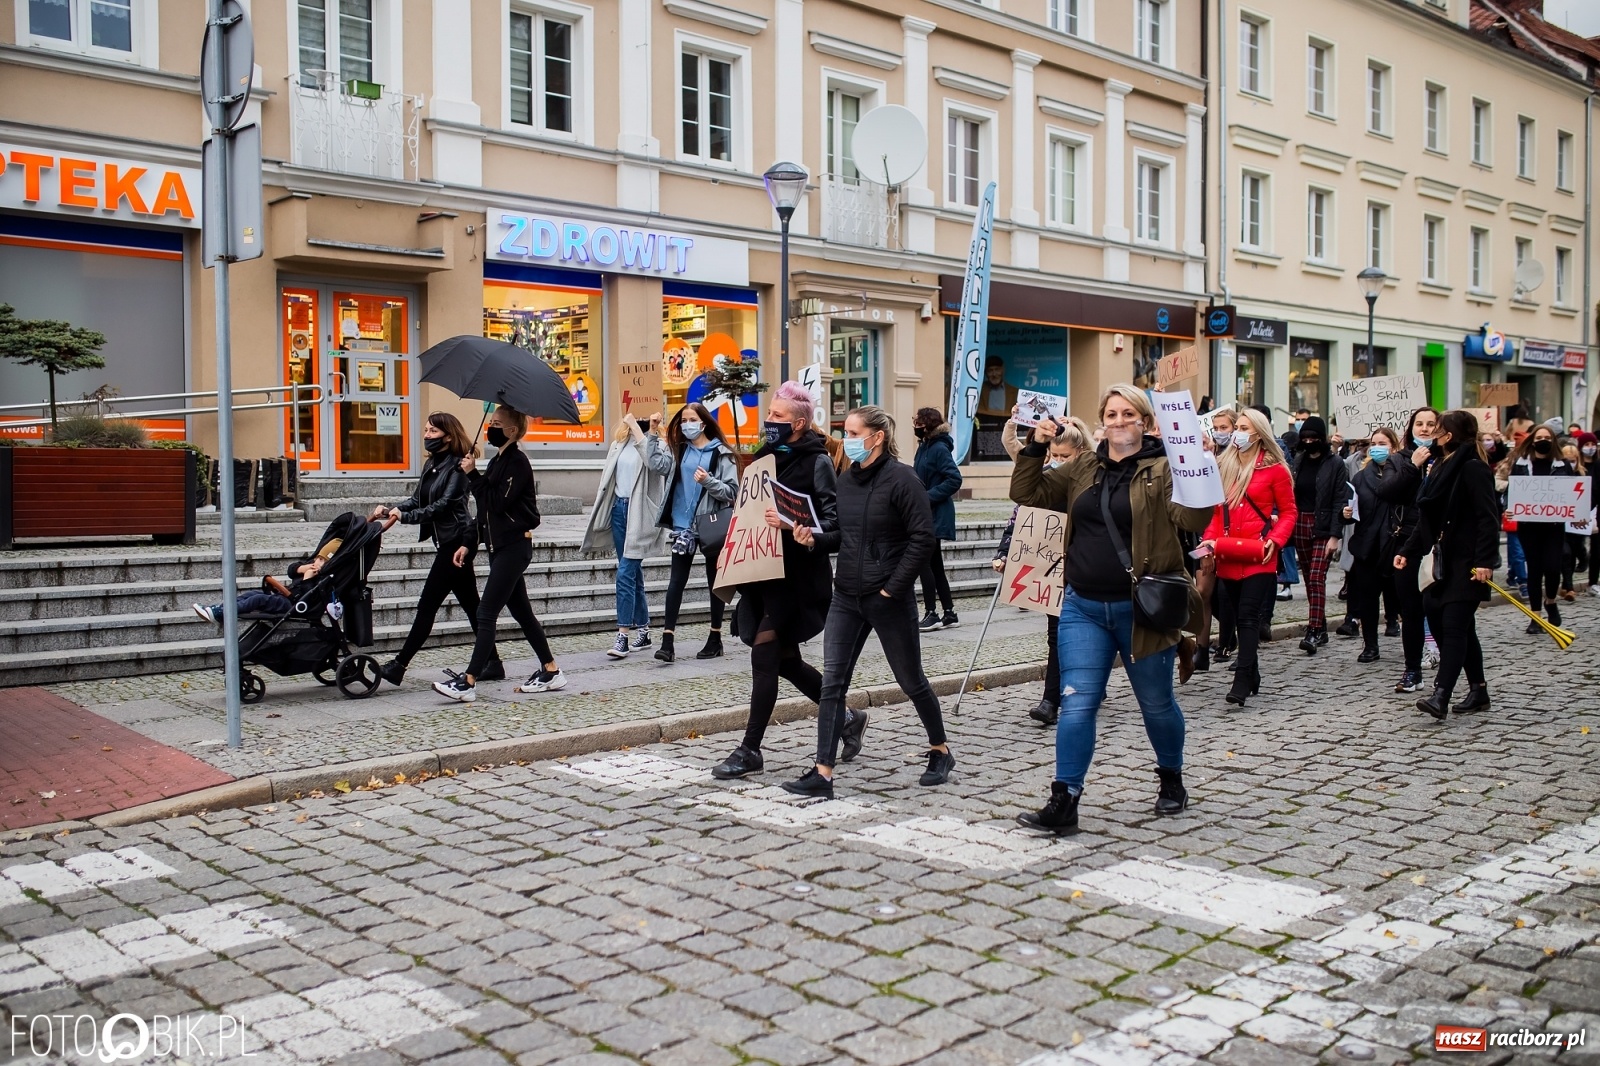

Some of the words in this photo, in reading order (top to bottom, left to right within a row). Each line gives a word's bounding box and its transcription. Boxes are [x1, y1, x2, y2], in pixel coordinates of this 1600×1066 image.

[0, 151, 195, 219] TEKA
[500, 215, 693, 273] ZDROWIT
[1247, 320, 1275, 339] Juliette
[632, 376, 645, 386] GO
[1024, 368, 1039, 387] 5
[1040, 376, 1059, 387] min
[1336, 381, 1367, 396] MARS
[1373, 380, 1386, 390] OD
[1354, 394, 1368, 405] TO
[1376, 389, 1408, 401] SRAM
[379, 406, 399, 417] NFZ
[1160, 401, 1191, 411] MYŚLĘ
[1343, 405, 1360, 415] PIS
[1367, 403, 1382, 413] OD
[566, 430, 586, 439] Nowa
[588, 430, 600, 439] 3-5
[1168, 435, 1196, 445] CZUJĘ
[1514, 504, 1576, 518] DECYDUJĘ
[1019, 511, 1034, 537] A
[1011, 540, 1034, 562] JAK
[1028, 580, 1051, 607] JA
